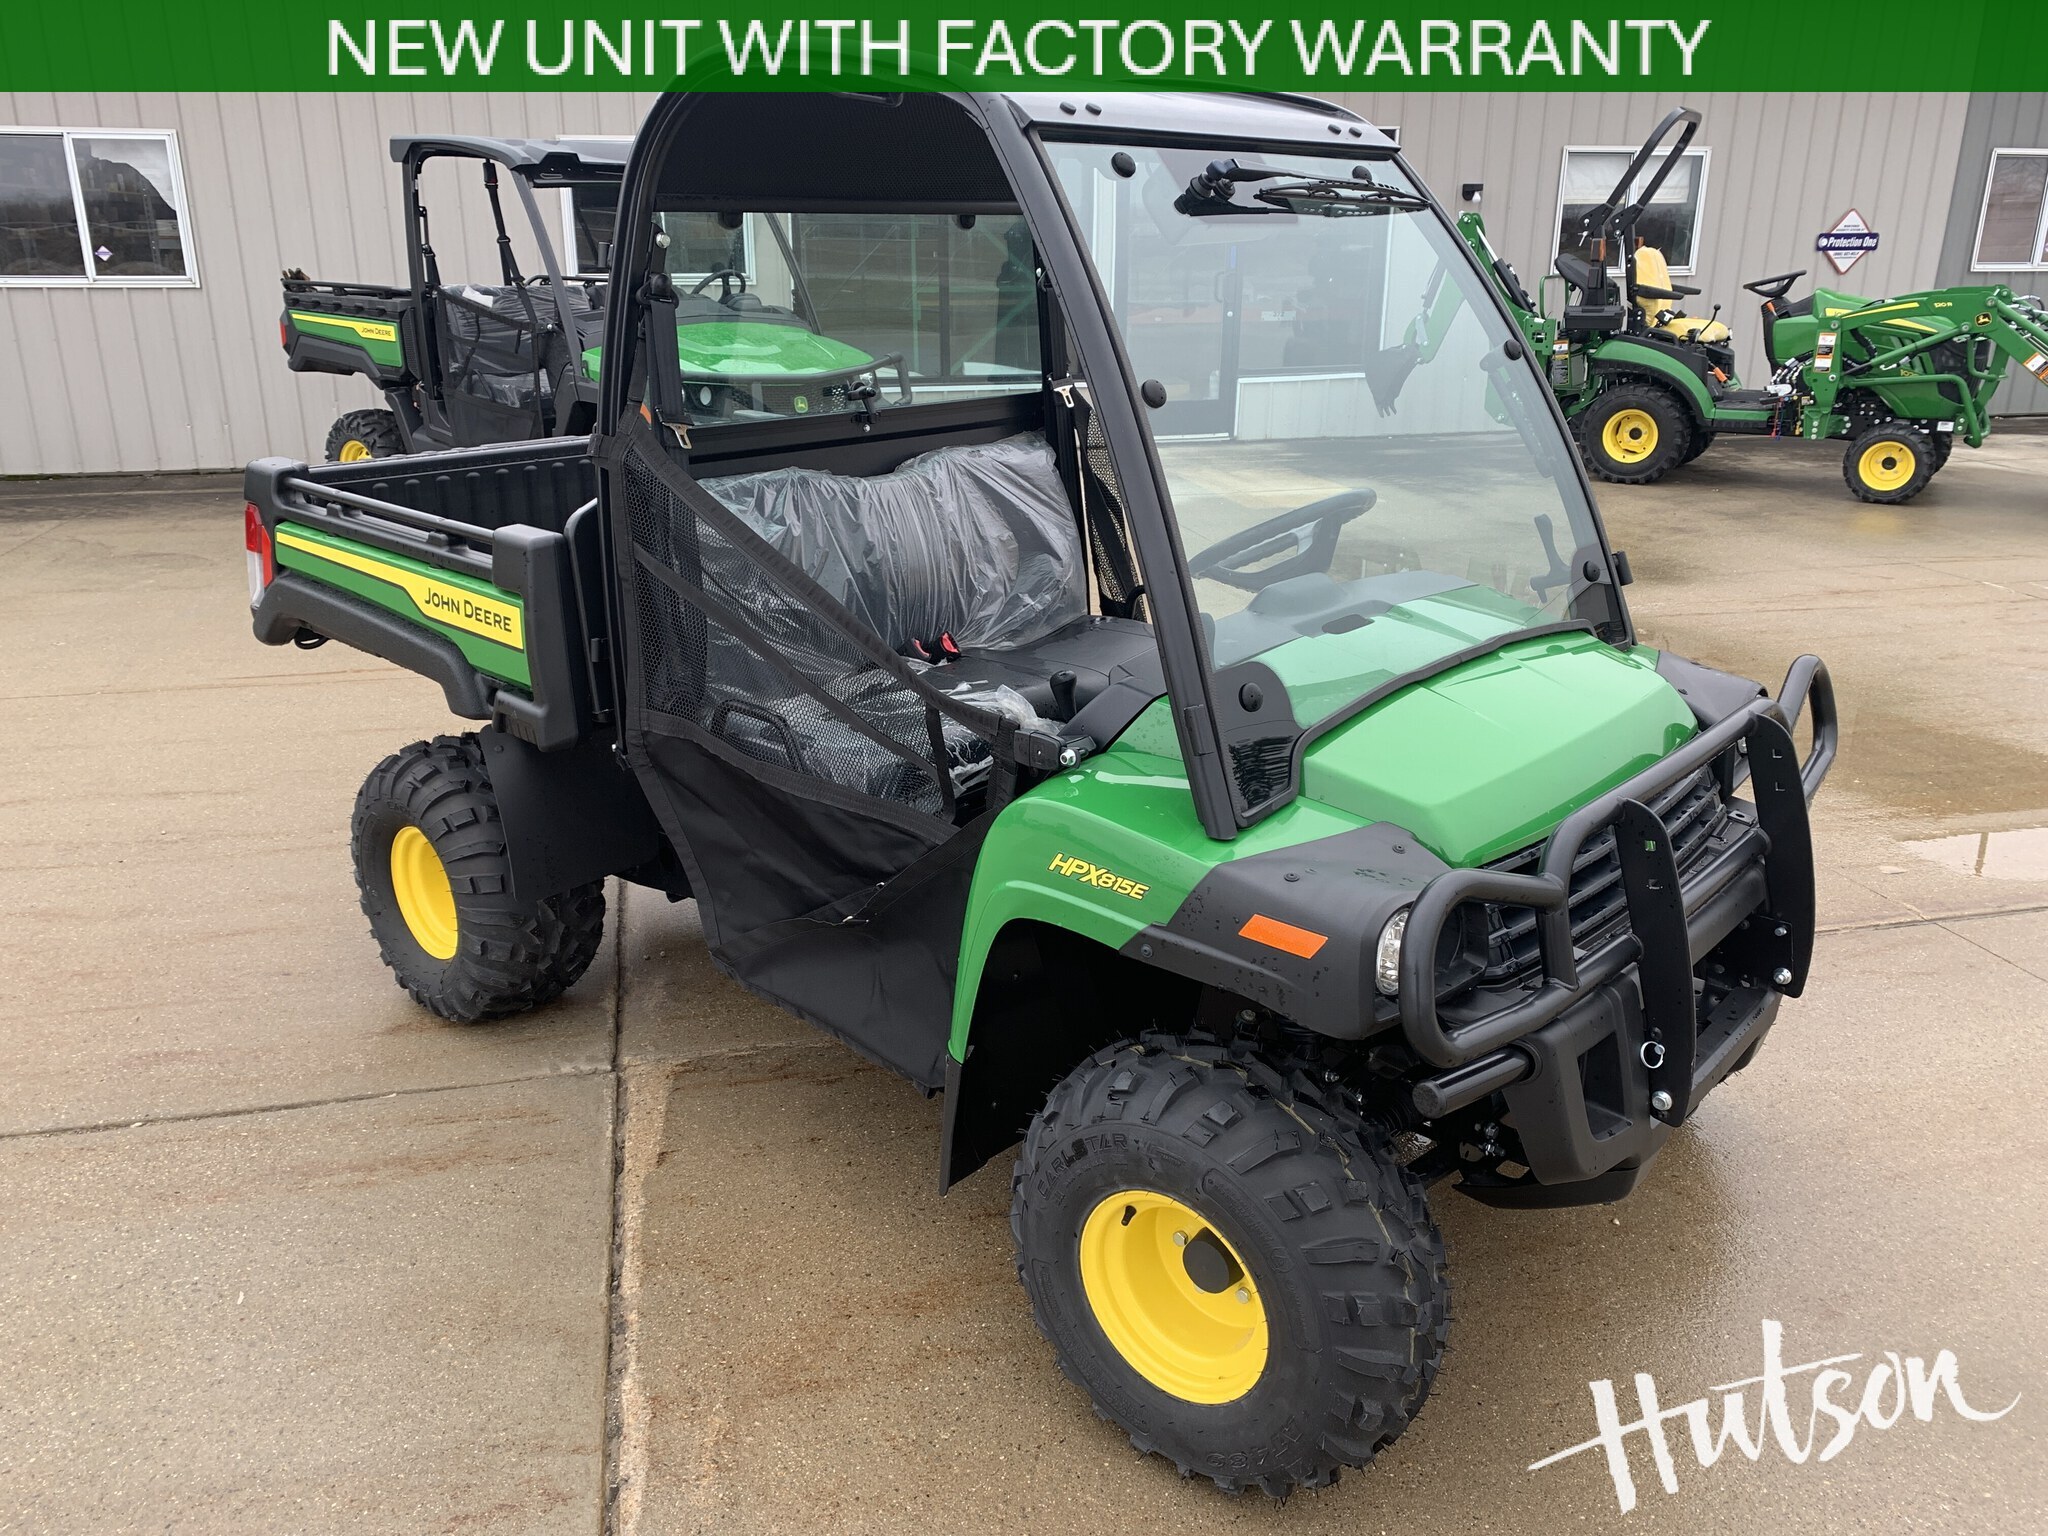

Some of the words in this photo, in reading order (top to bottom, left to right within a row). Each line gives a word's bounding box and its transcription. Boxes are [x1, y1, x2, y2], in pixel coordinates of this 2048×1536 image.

[1827, 236, 1863, 247] Protection
[1863, 236, 1877, 247] One
[361, 327, 374, 335] JOHN
[375, 327, 391, 336] DEERE
[424, 587, 460, 615] JOHN
[463, 599, 512, 633] DEERE
[1047, 852, 1152, 900] HPX815E
